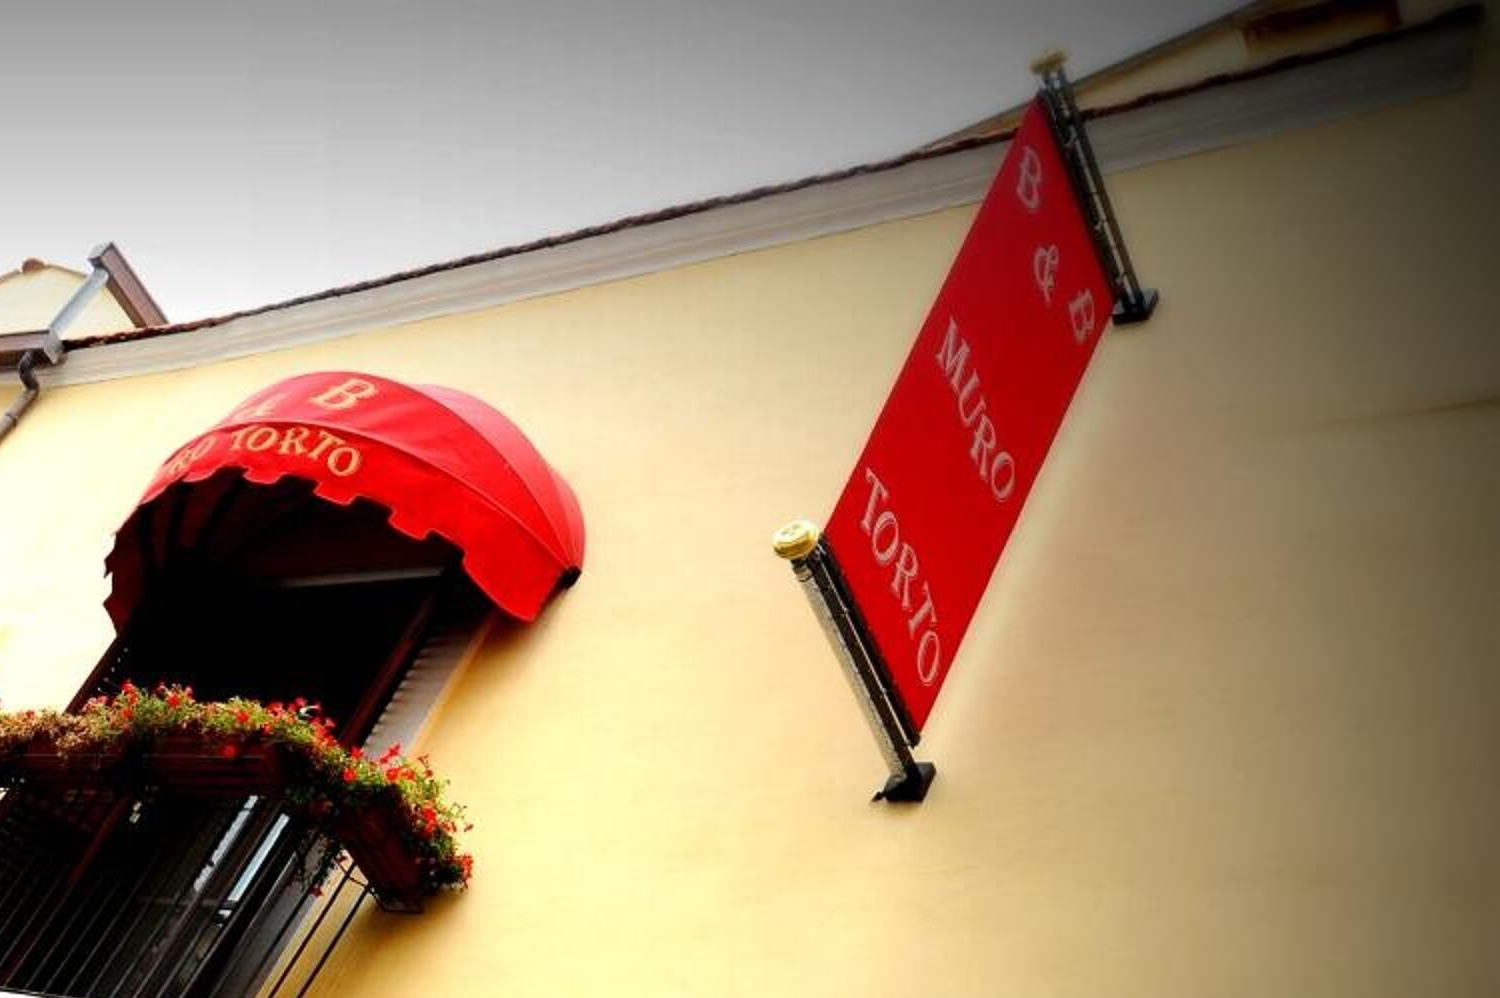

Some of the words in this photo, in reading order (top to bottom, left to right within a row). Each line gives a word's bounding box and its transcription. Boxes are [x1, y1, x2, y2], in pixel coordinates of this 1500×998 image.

[1016, 145, 1042, 213] B
[1033, 243, 1059, 308] &
[1068, 287, 1095, 345] B
[229, 424, 363, 478] TORTO
[308, 377, 380, 411] B
[935, 317, 1016, 503] MURO
[860, 466, 943, 688] TORTO
